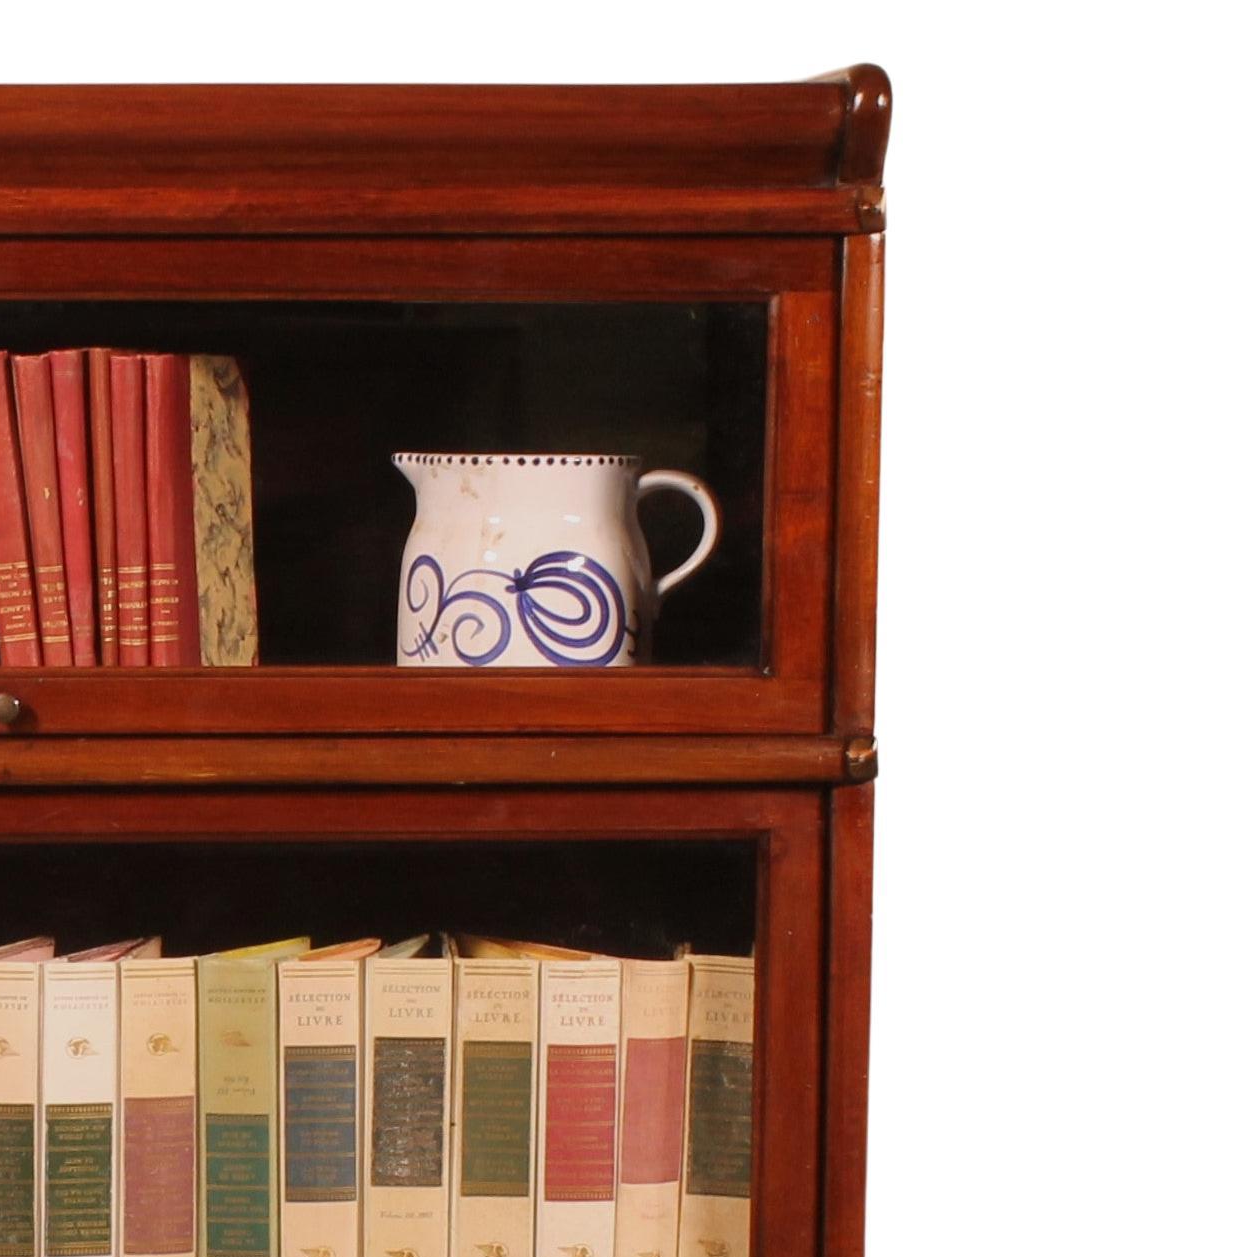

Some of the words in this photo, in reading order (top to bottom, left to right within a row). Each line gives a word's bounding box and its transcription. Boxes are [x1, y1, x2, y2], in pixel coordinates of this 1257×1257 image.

[288, 992, 351, 1002] SÉLECTION
[551, 992, 613, 1002] SÉLECTION
[388, 1007, 435, 1019] LIVRE
[474, 1012, 522, 1023] LIVRE
[297, 1015, 343, 1027] LIVRE
[559, 1015, 607, 1026] LIVRE
